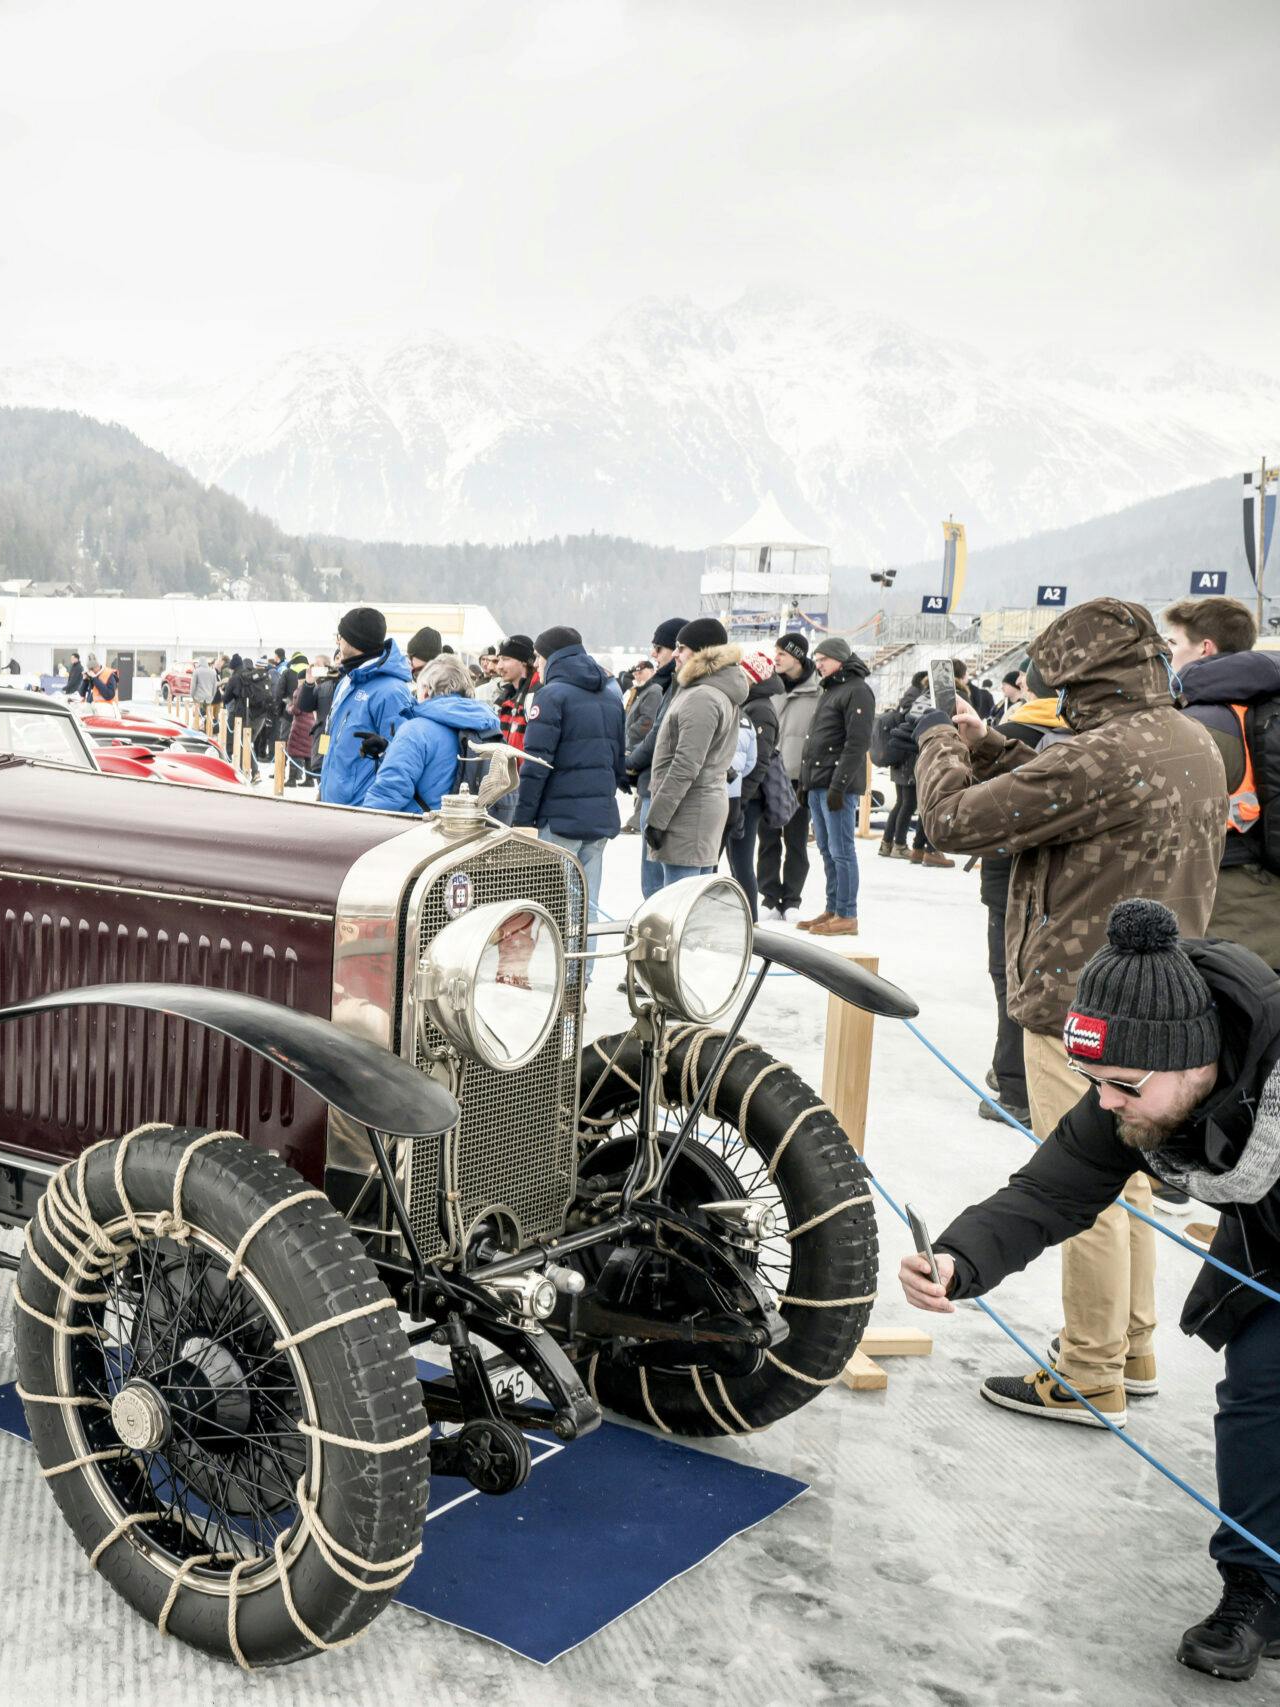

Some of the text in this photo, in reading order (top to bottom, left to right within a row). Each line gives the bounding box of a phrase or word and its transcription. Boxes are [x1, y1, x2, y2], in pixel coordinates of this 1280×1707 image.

[1199, 573, 1219, 588] A1
[1043, 587, 1061, 600] A2
[927, 597, 943, 609] A3
